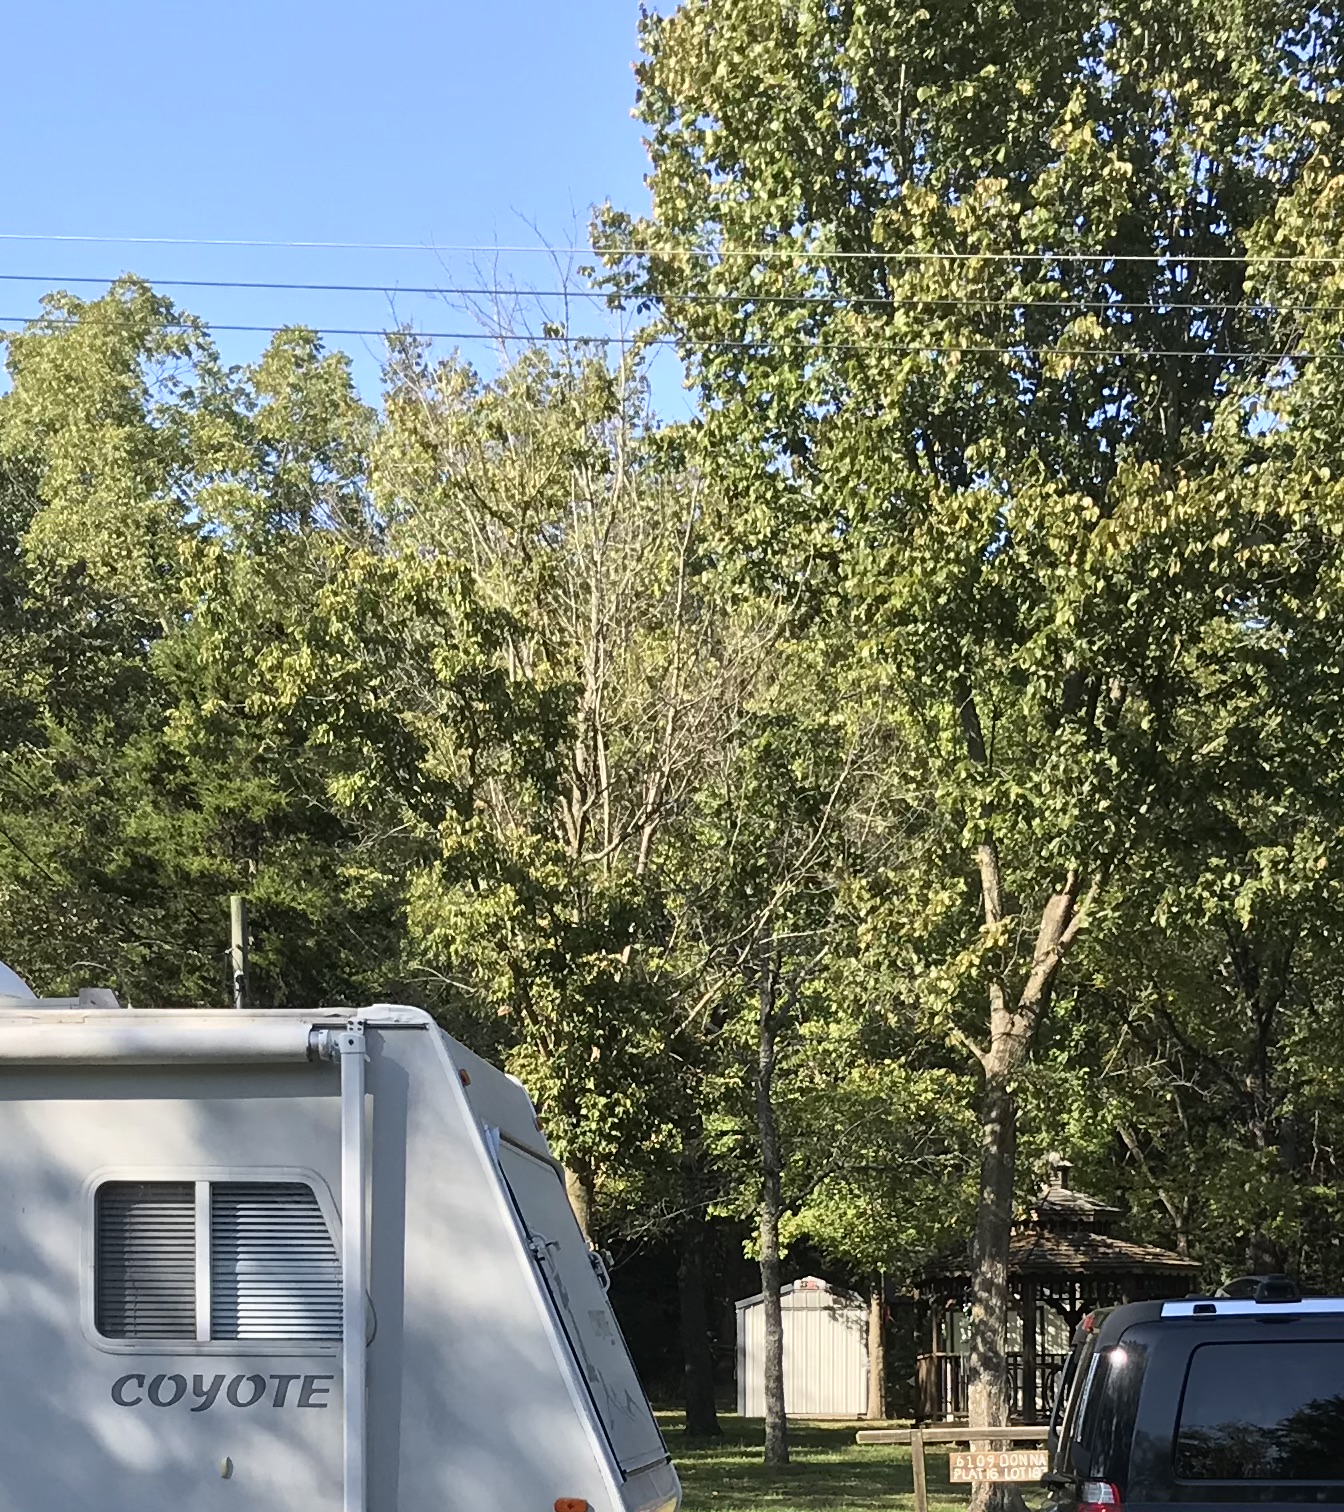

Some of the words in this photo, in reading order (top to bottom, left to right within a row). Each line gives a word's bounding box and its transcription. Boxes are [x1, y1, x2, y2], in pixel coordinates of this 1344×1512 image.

[110, 1373, 335, 1412] COYOTE
[955, 1454, 995, 1468] 6109
[999, 1453, 1047, 1467] DONNA
[953, 1467, 984, 1480] PLAT
[986, 1467, 999, 1480] 16
[1004, 1467, 1027, 1480] LOT
